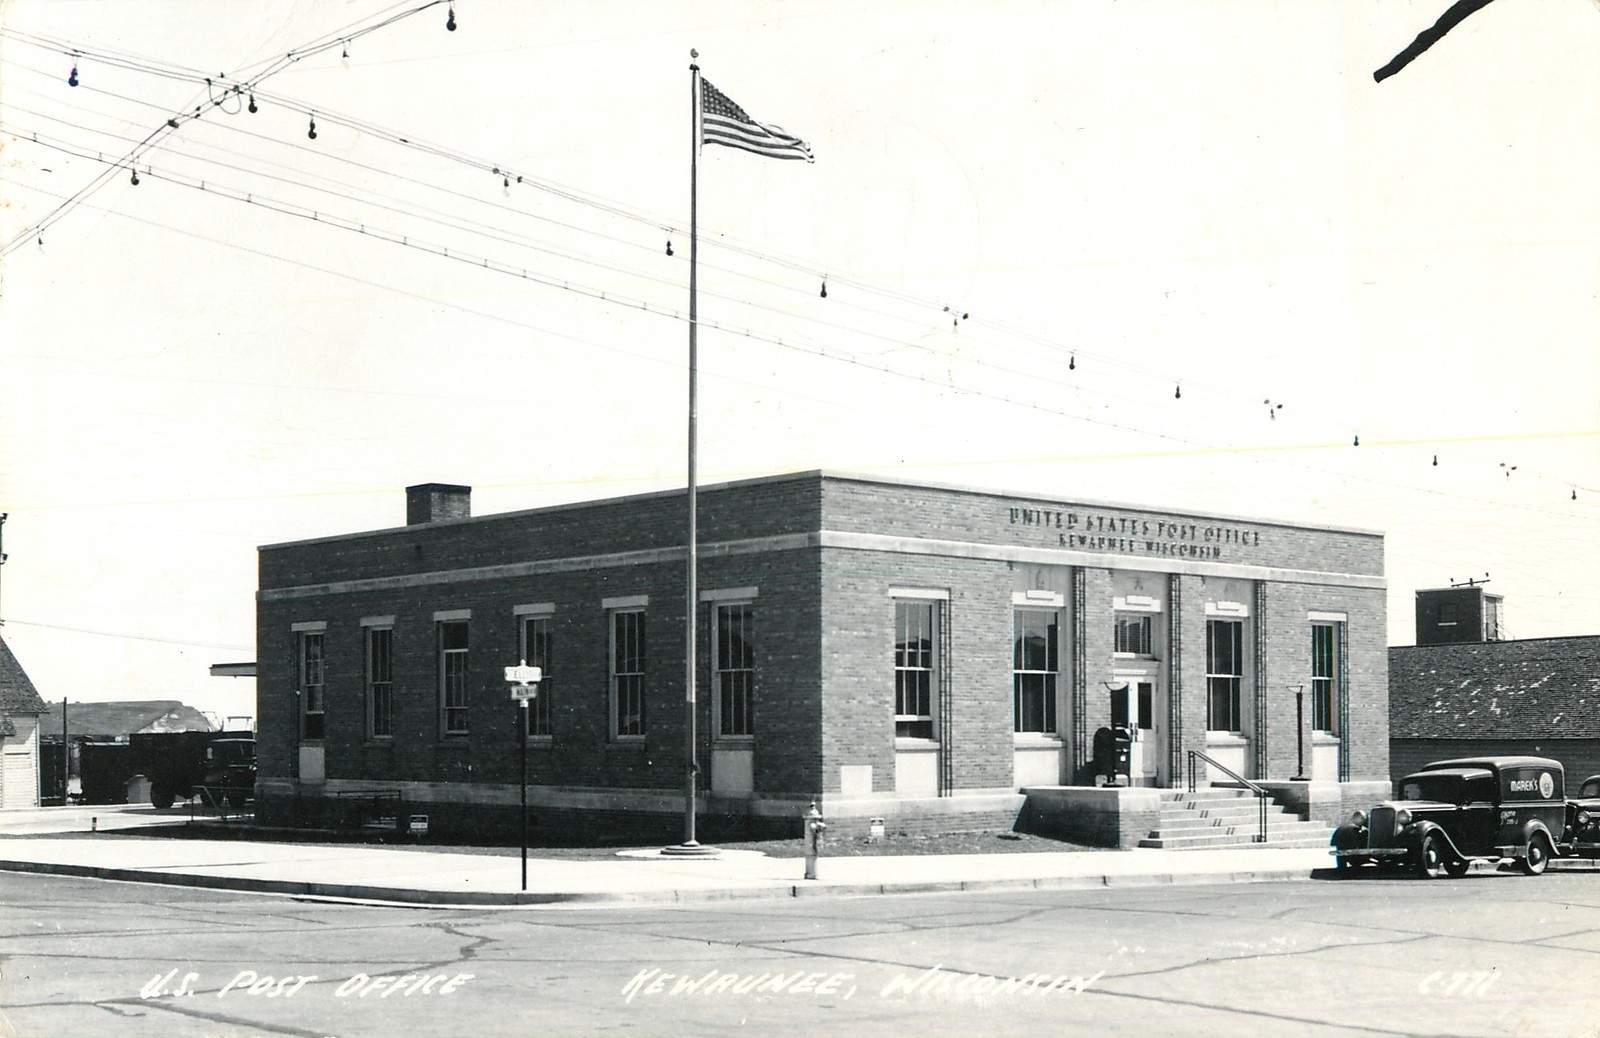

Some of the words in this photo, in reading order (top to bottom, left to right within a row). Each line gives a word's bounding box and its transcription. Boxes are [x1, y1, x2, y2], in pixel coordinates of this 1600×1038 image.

[1010, 507, 1078, 529] UNITED
[1086, 515, 1149, 536] STATES
[1158, 521, 1195, 540] POST
[1204, 526, 1260, 547] OFFICE
[1059, 532, 1135, 553] KEWAUNEE
[1145, 540, 1221, 560] WISCONSIN
[1510, 779, 1538, 792] MAREK'S
